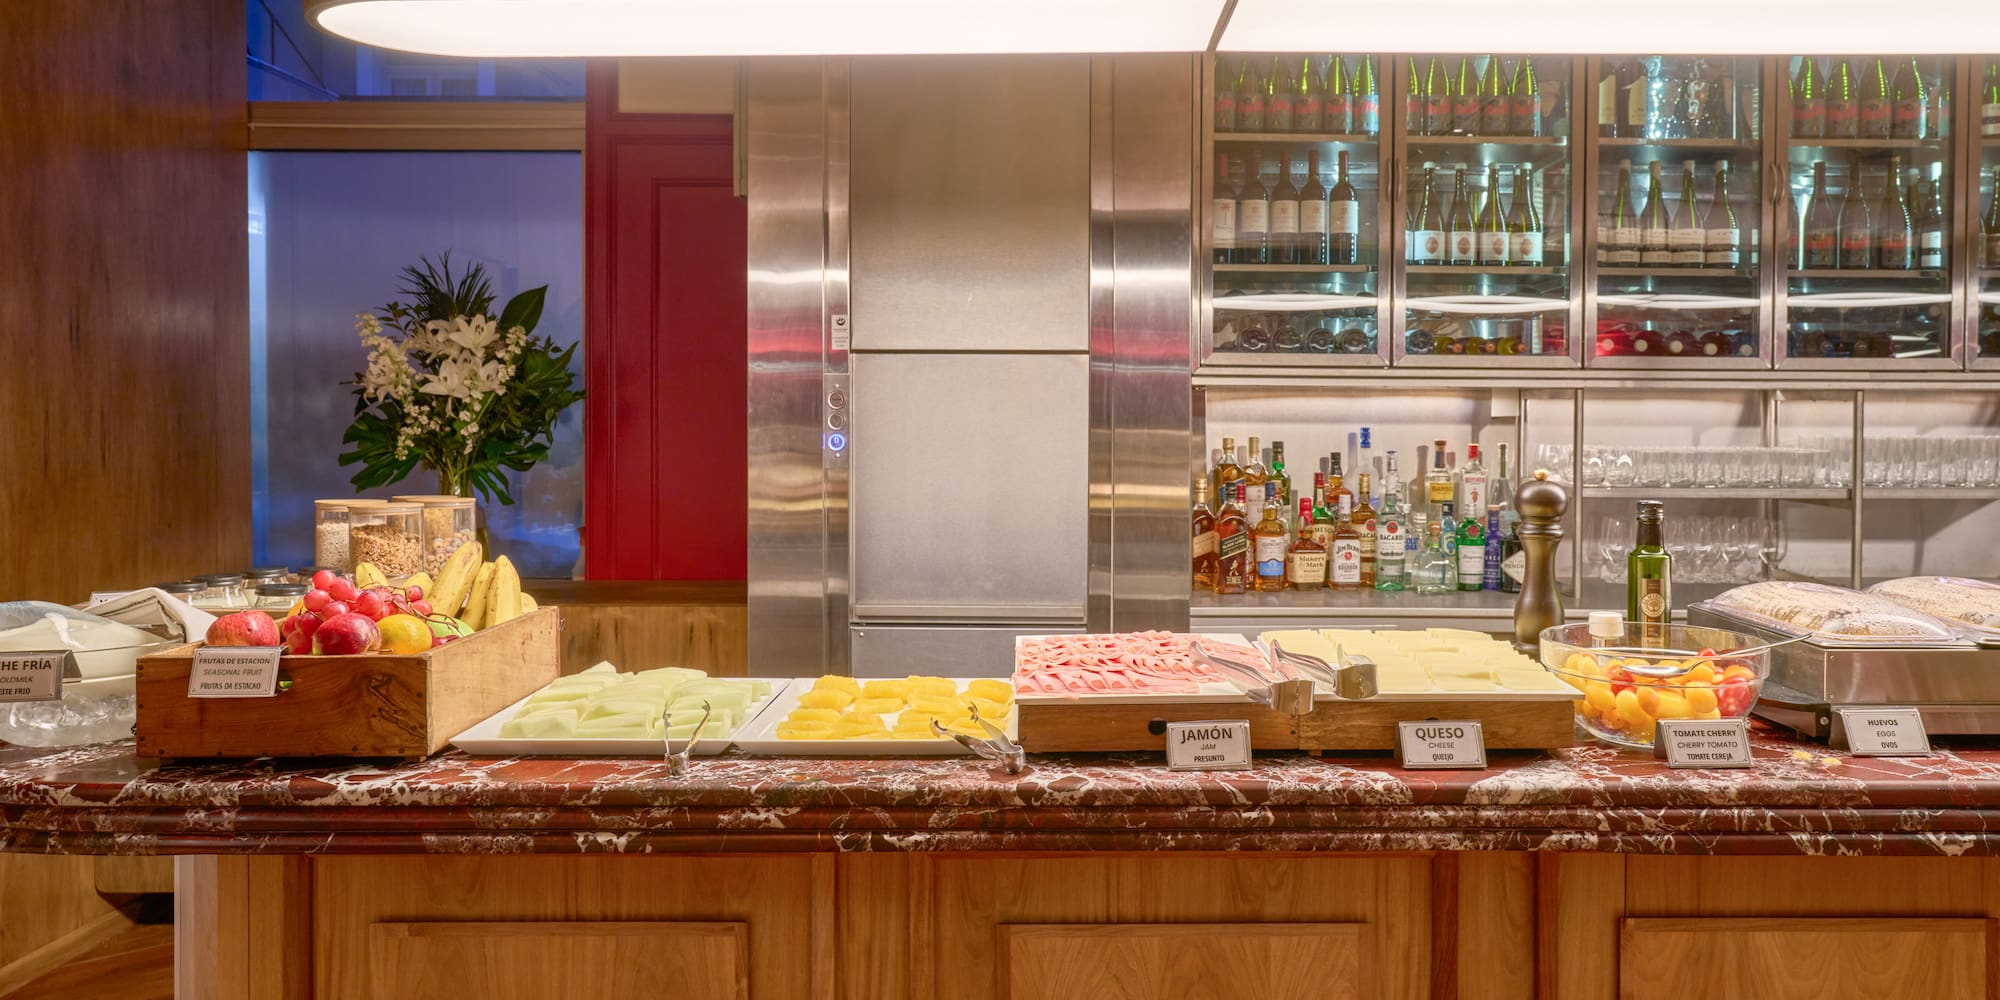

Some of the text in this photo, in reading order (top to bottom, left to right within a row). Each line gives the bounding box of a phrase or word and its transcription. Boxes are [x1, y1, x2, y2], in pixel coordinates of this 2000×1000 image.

[0, 658, 52, 670] HE FRÍA
[1180, 725, 1232, 744] JAMÓN
[1415, 727, 1464, 741] QUESO
[1194, 754, 1224, 762] PRESUNTO
[1432, 753, 1454, 762] QUEIJO
[1711, 753, 1734, 761] CEREJA
